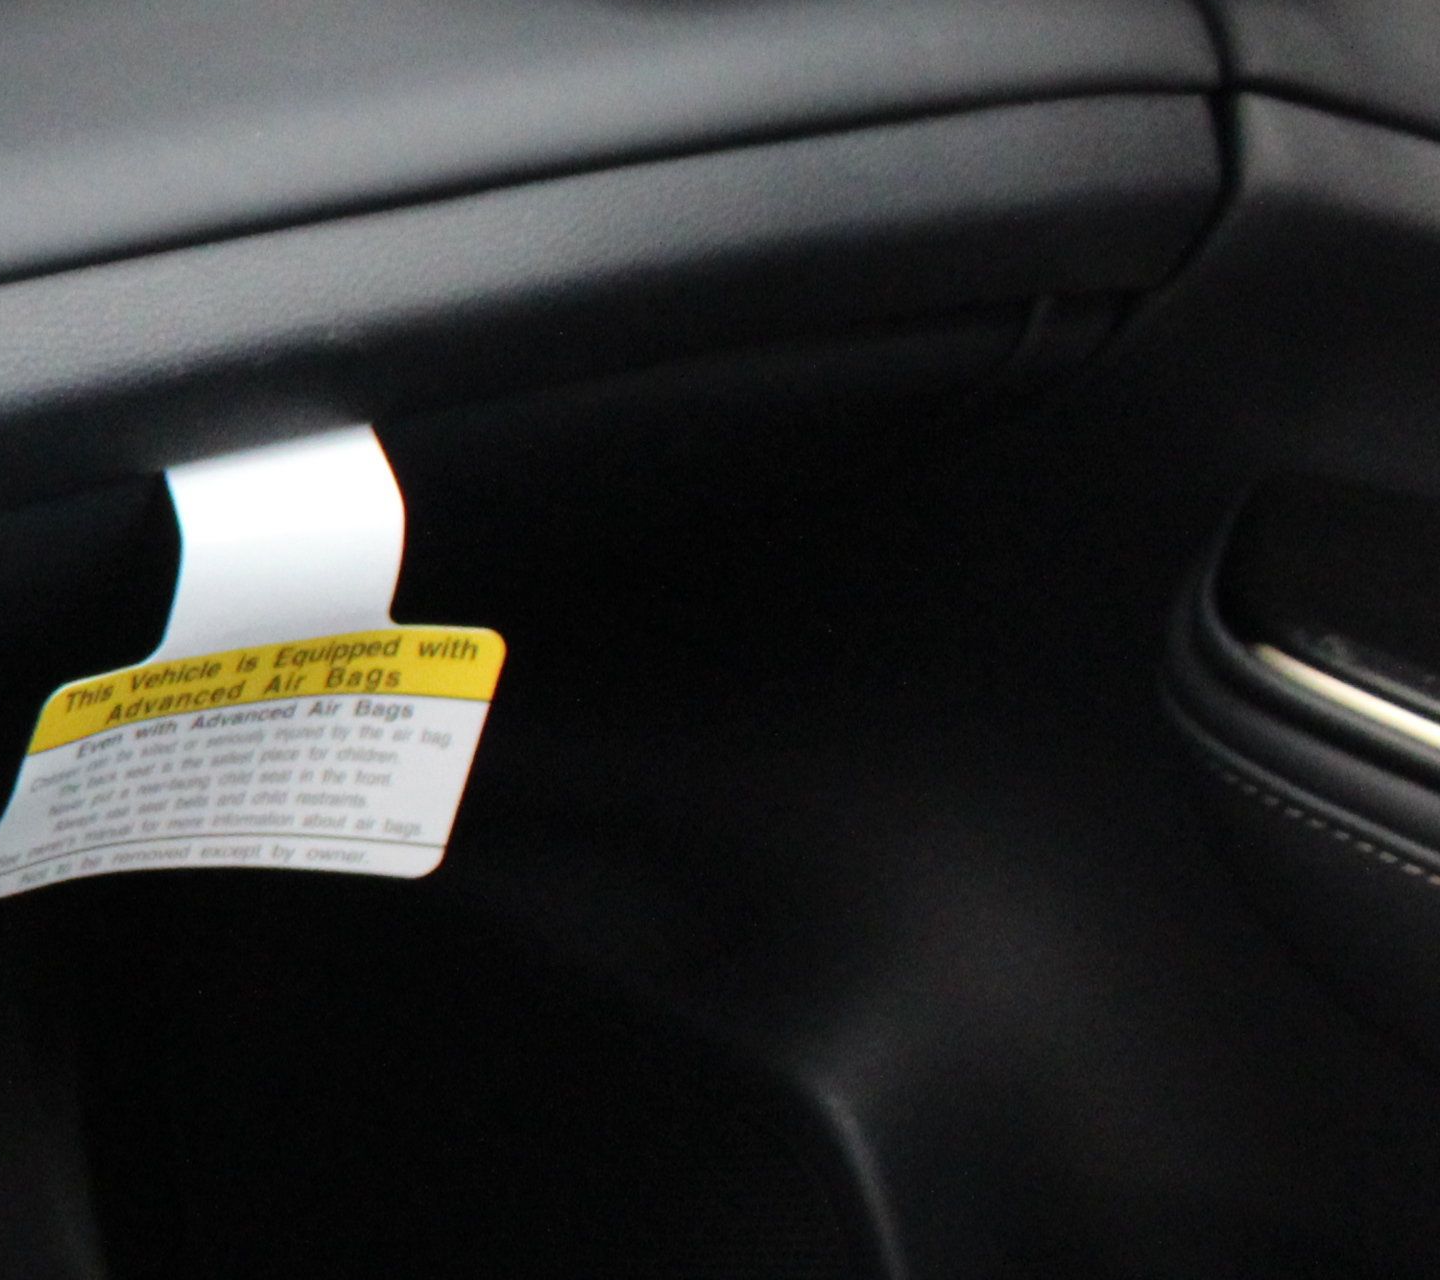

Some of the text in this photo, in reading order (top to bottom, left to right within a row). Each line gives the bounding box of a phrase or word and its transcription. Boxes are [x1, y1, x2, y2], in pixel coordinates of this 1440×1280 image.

[65, 636, 480, 714] This Vehicle is Equipped with
[105, 666, 401, 725] Advanced Air Bags
[76, 701, 415, 760] Even with Advanced Air Bags
